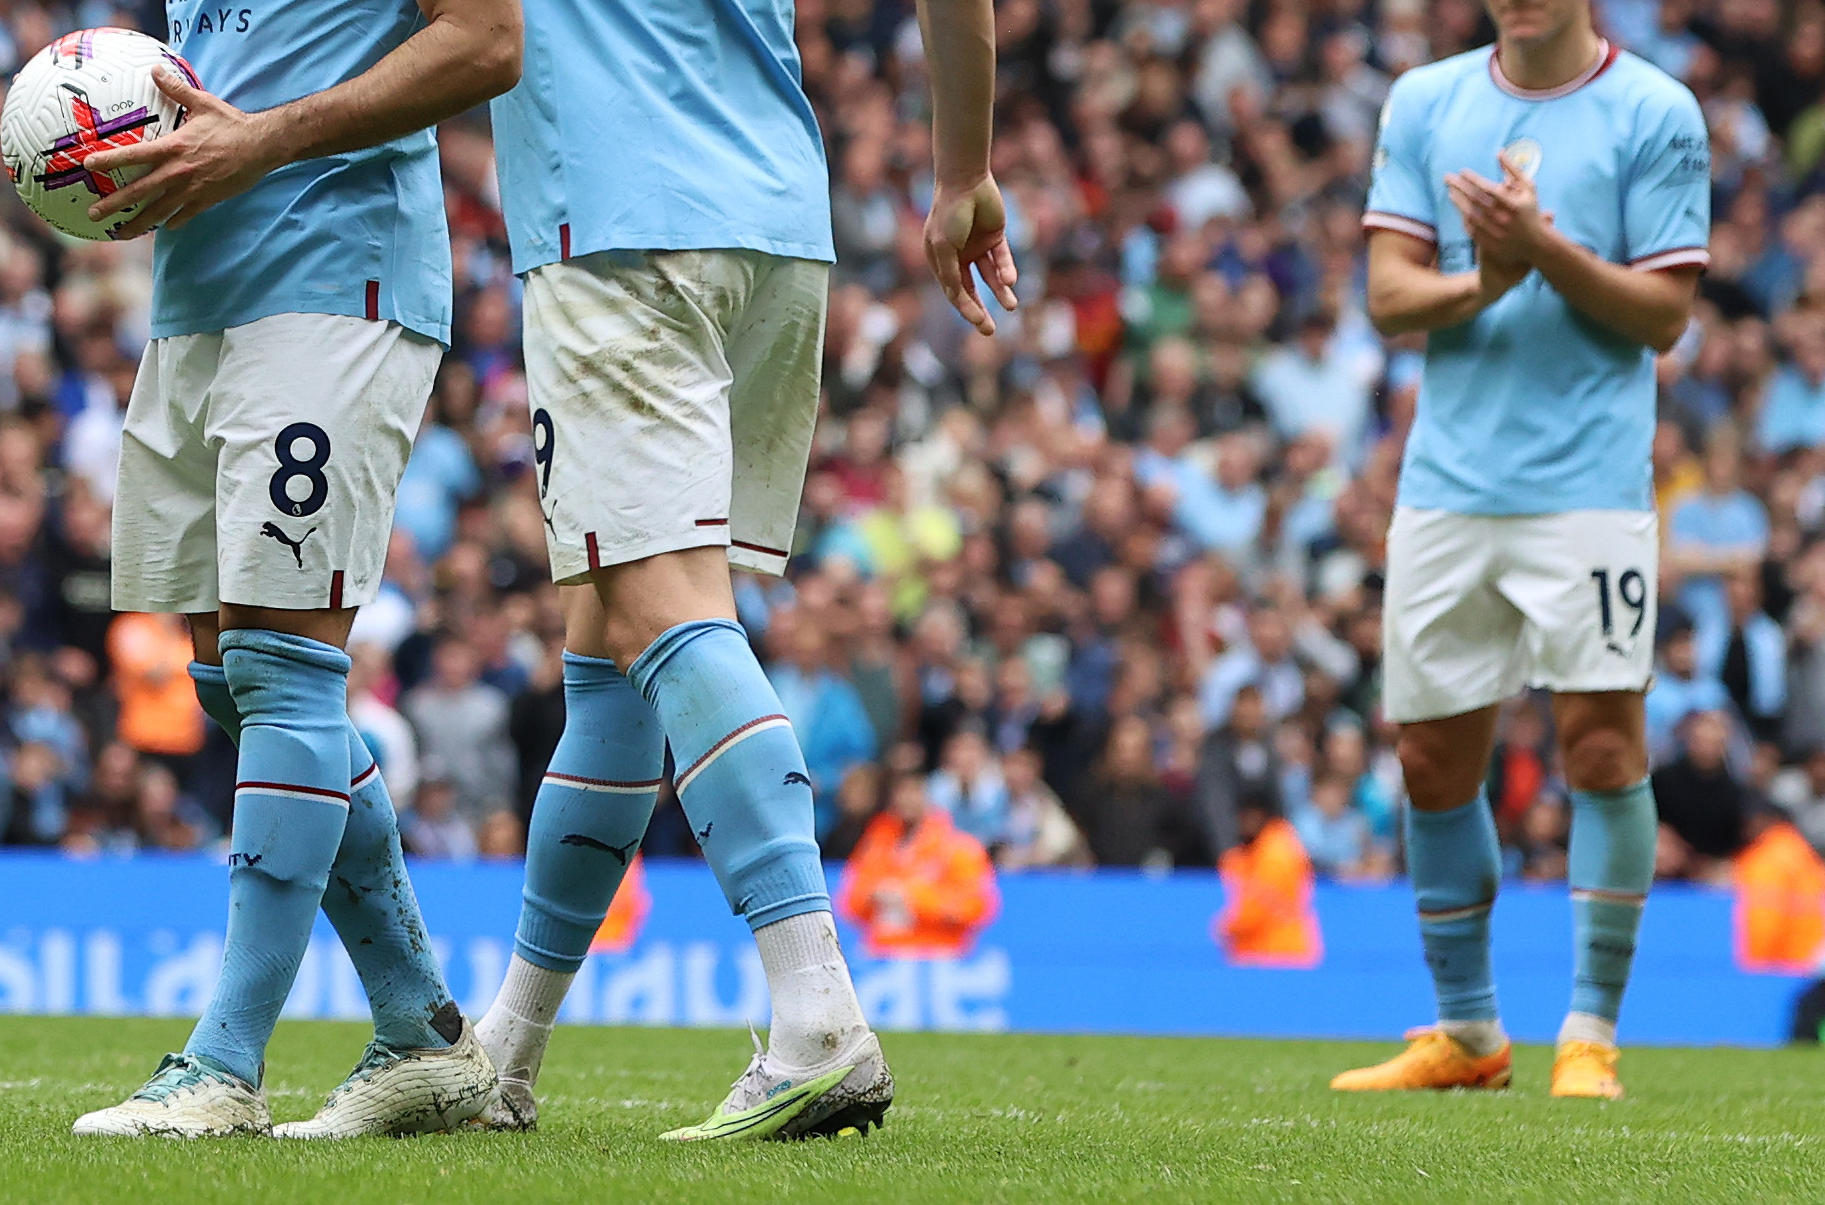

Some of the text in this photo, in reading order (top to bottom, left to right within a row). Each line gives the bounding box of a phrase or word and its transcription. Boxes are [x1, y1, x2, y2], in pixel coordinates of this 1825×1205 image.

[269, 421, 331, 518] 8
[533, 407, 555, 500] 9
[1590, 569, 1647, 638] 19
